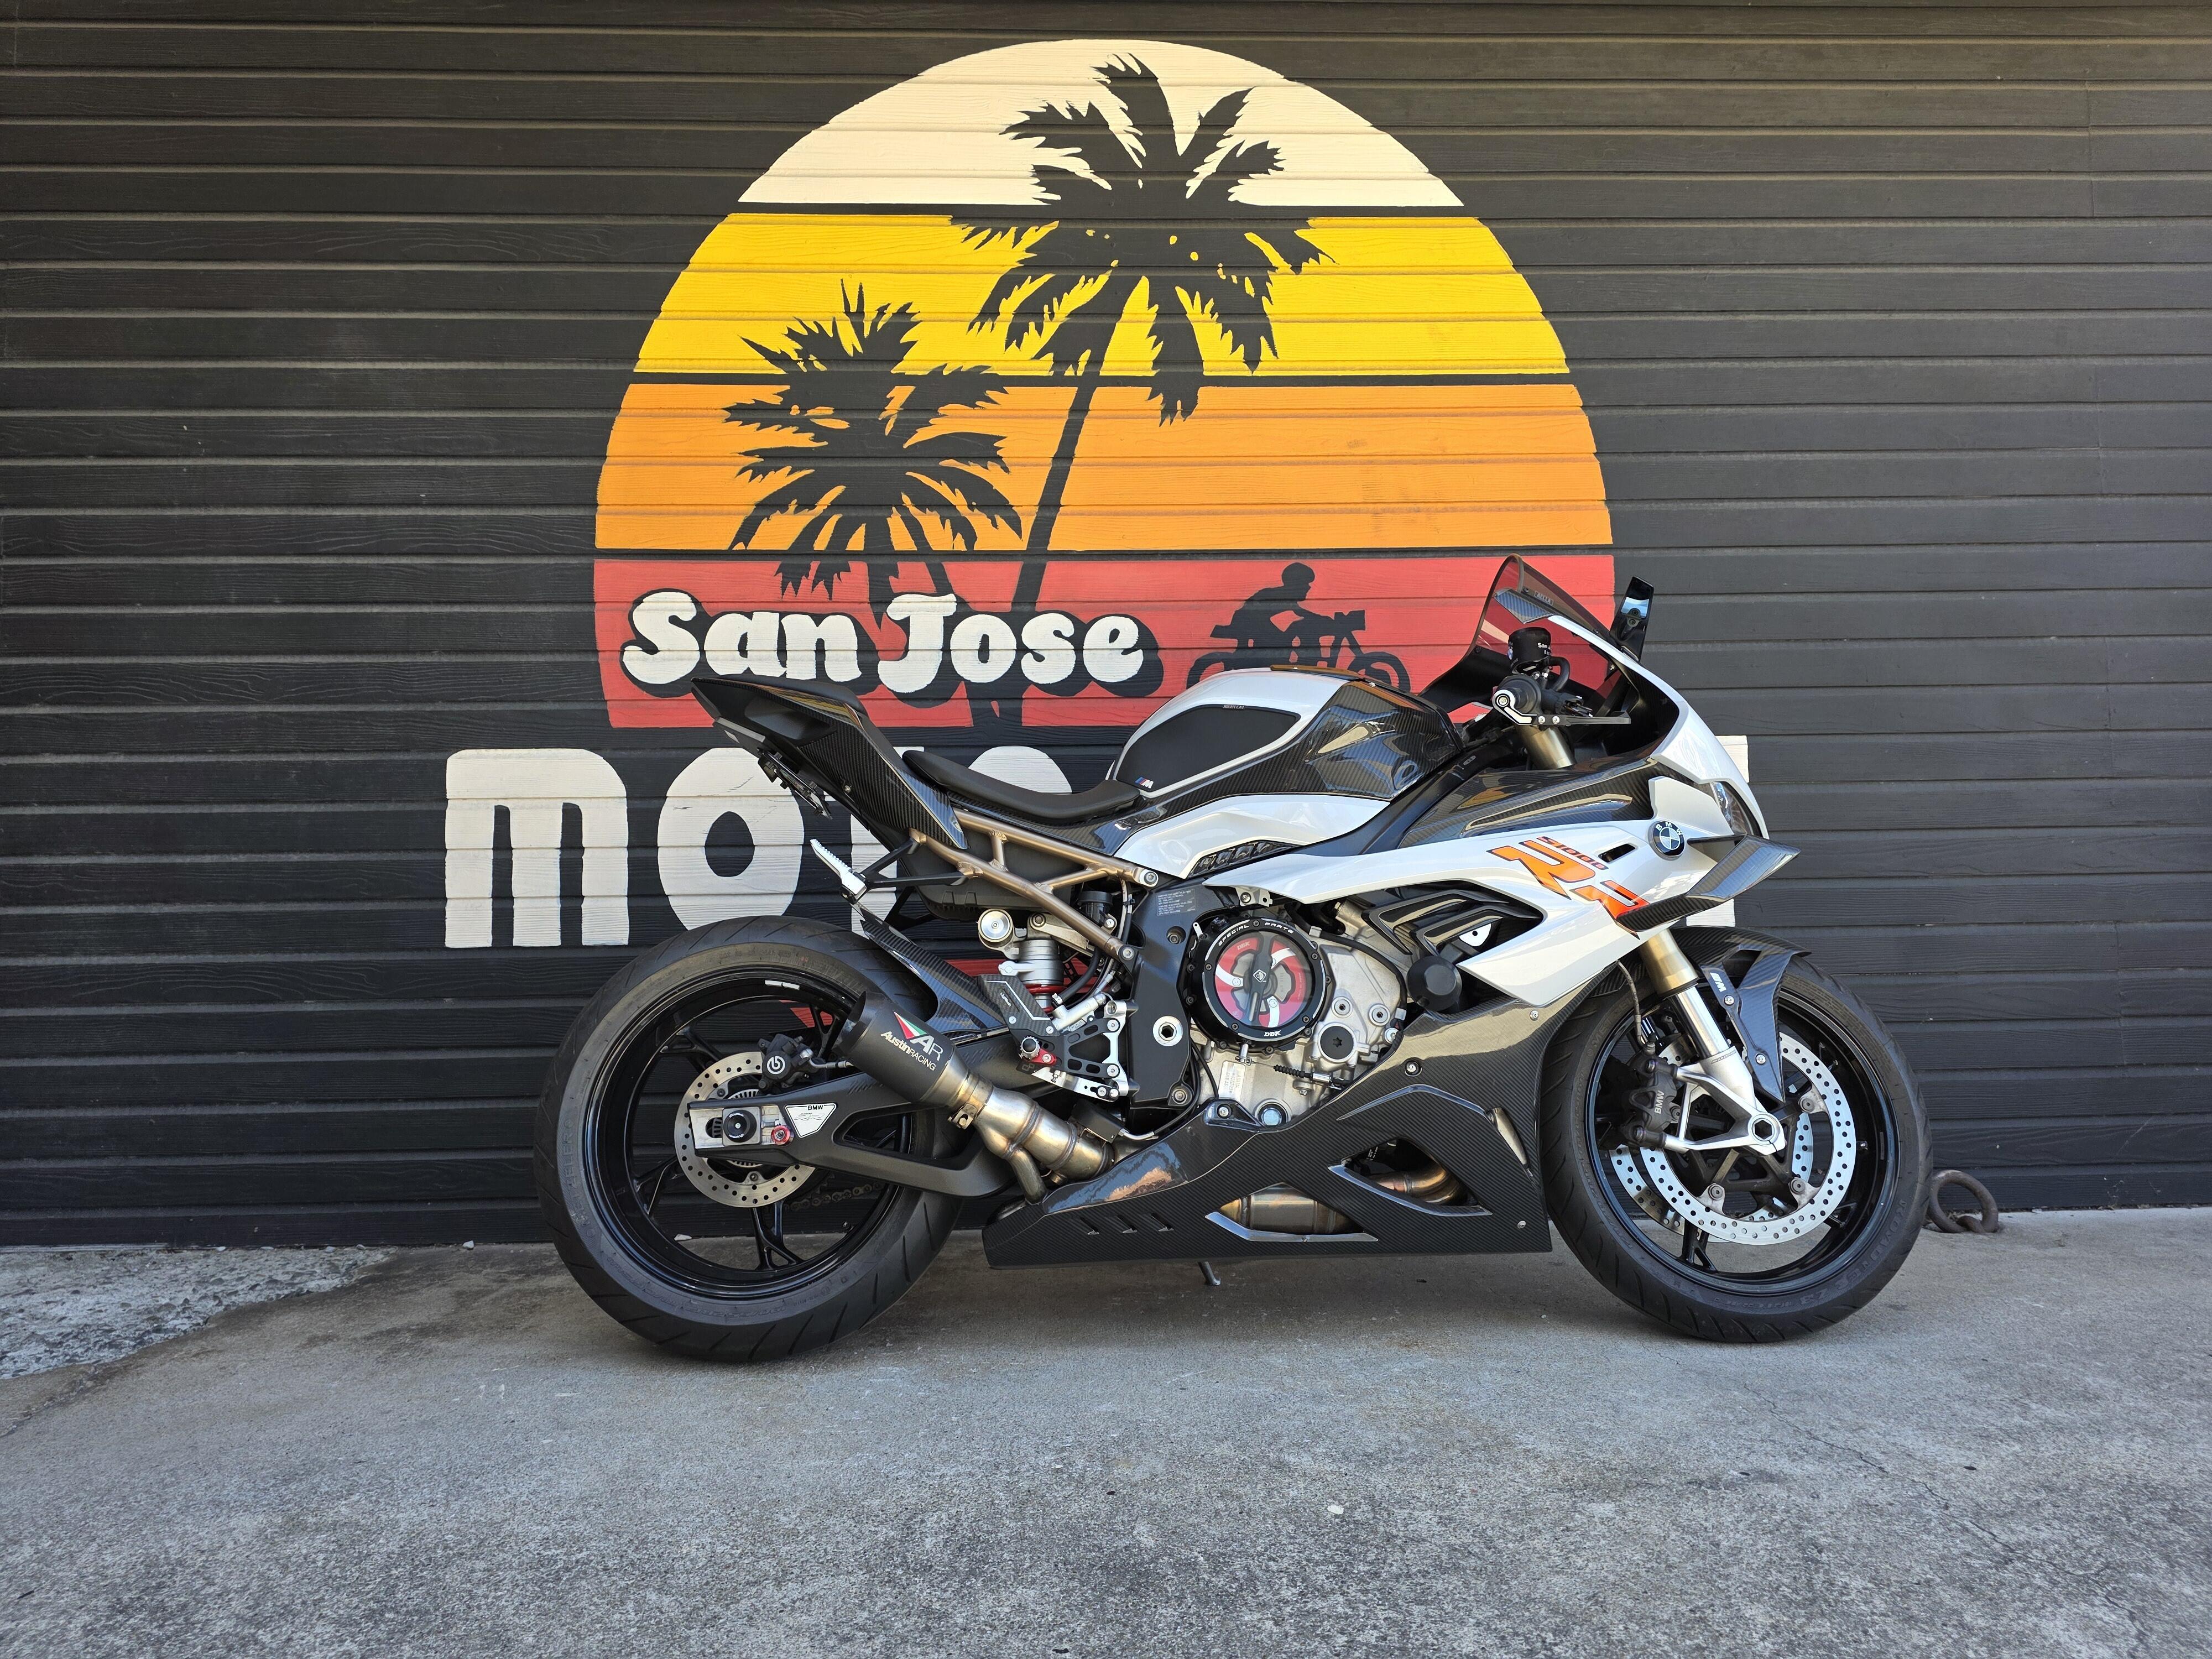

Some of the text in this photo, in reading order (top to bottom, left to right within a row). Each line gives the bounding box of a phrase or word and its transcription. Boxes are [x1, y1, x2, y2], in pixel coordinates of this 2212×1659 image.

[1536, 592, 1552, 604] AELLA
[623, 592, 1144, 693] San Jose
[1655, 821, 1682, 836] BMW
[1218, 922, 1294, 946] SPECIAL PARTS
[909, 1035, 943, 1061] AR
[1654, 1090, 1665, 1114] BMW
